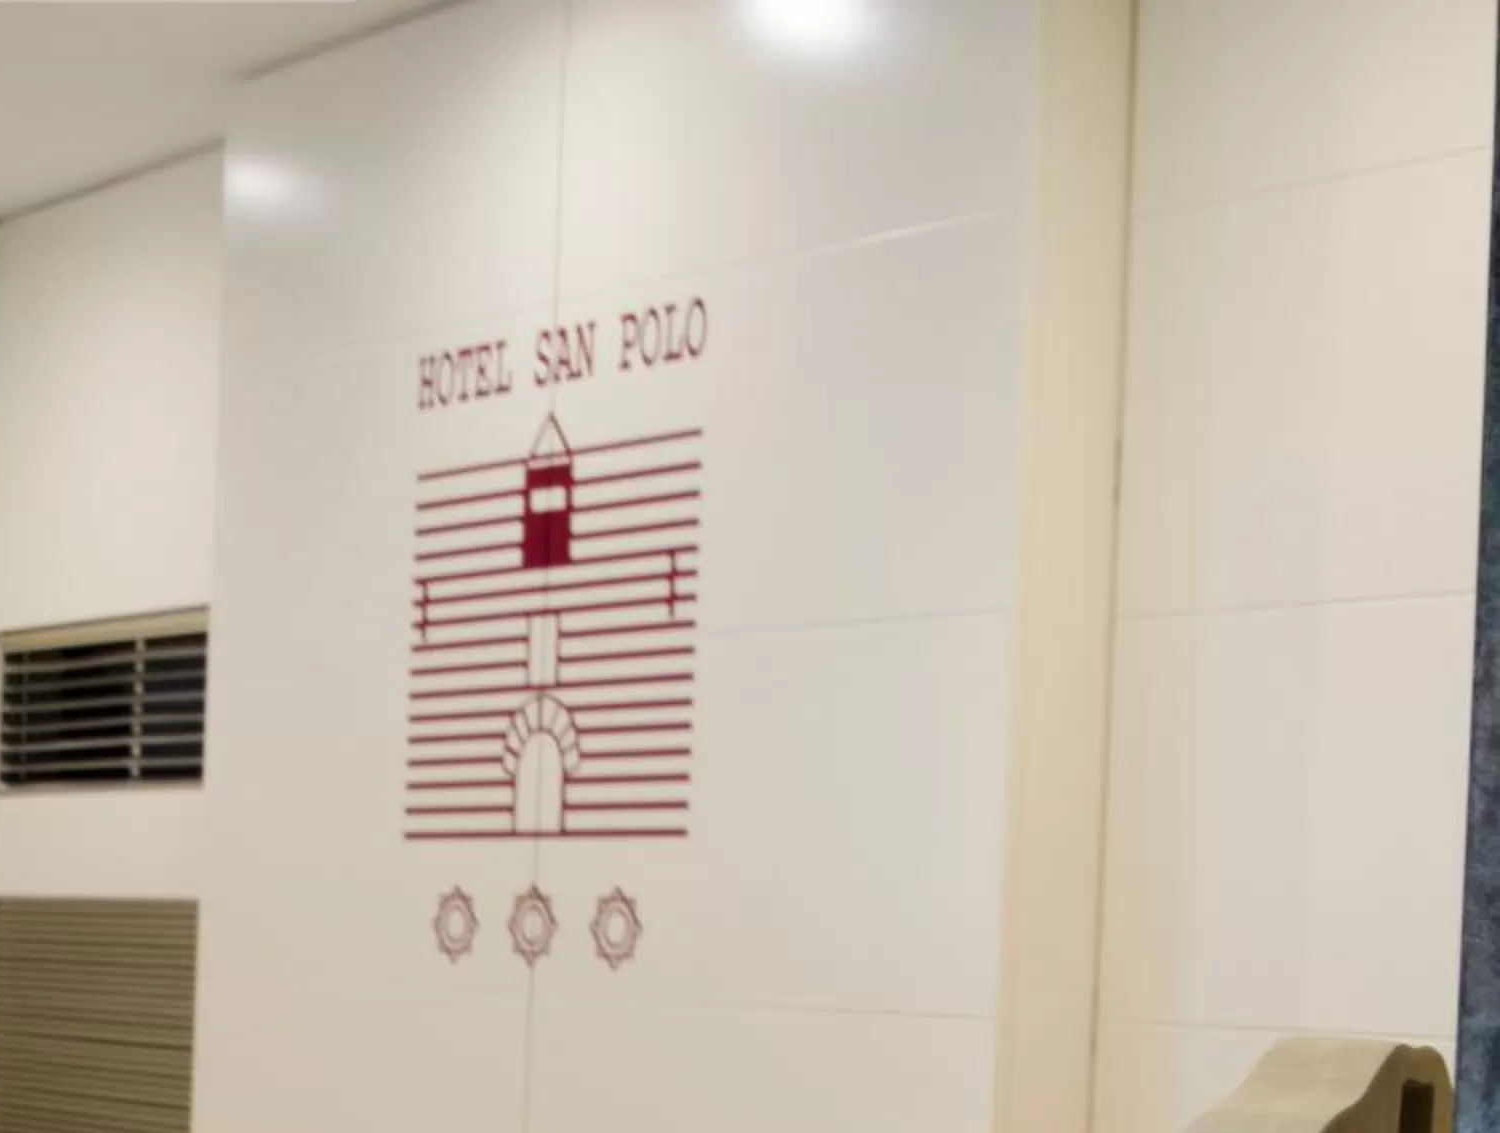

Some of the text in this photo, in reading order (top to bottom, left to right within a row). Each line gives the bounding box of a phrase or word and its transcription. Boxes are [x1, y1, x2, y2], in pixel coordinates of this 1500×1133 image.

[417, 297, 708, 410] HOTEL SAN POLO
